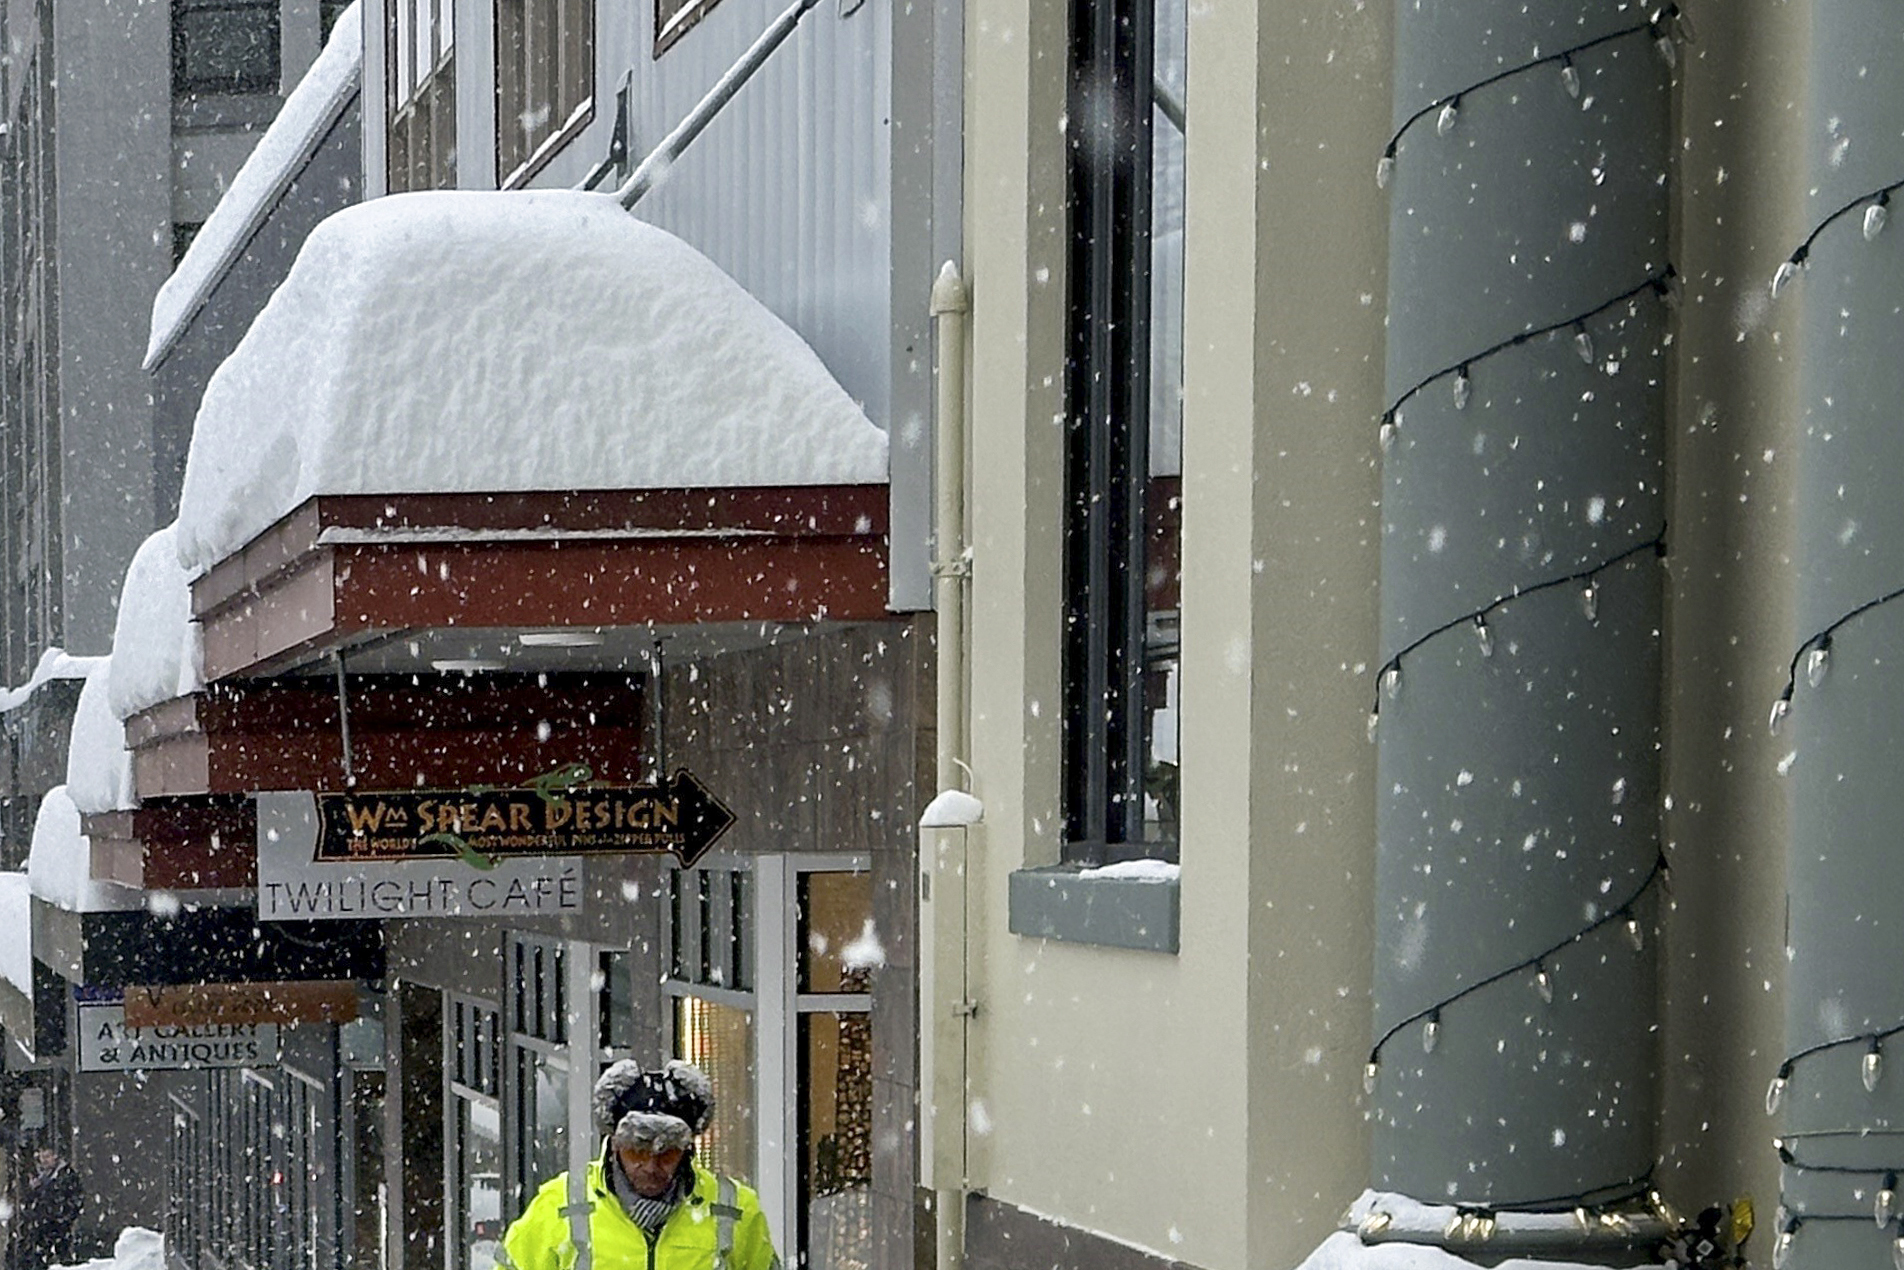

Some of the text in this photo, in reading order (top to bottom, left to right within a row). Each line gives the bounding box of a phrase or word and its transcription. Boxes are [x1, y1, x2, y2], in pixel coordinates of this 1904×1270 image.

[417, 800, 532, 833] SPEAR
[546, 798, 679, 830] DESIGN
[265, 867, 577, 914] TWILIGHT CAFÉ
[99, 1042, 258, 1064] & ANTIQUES
